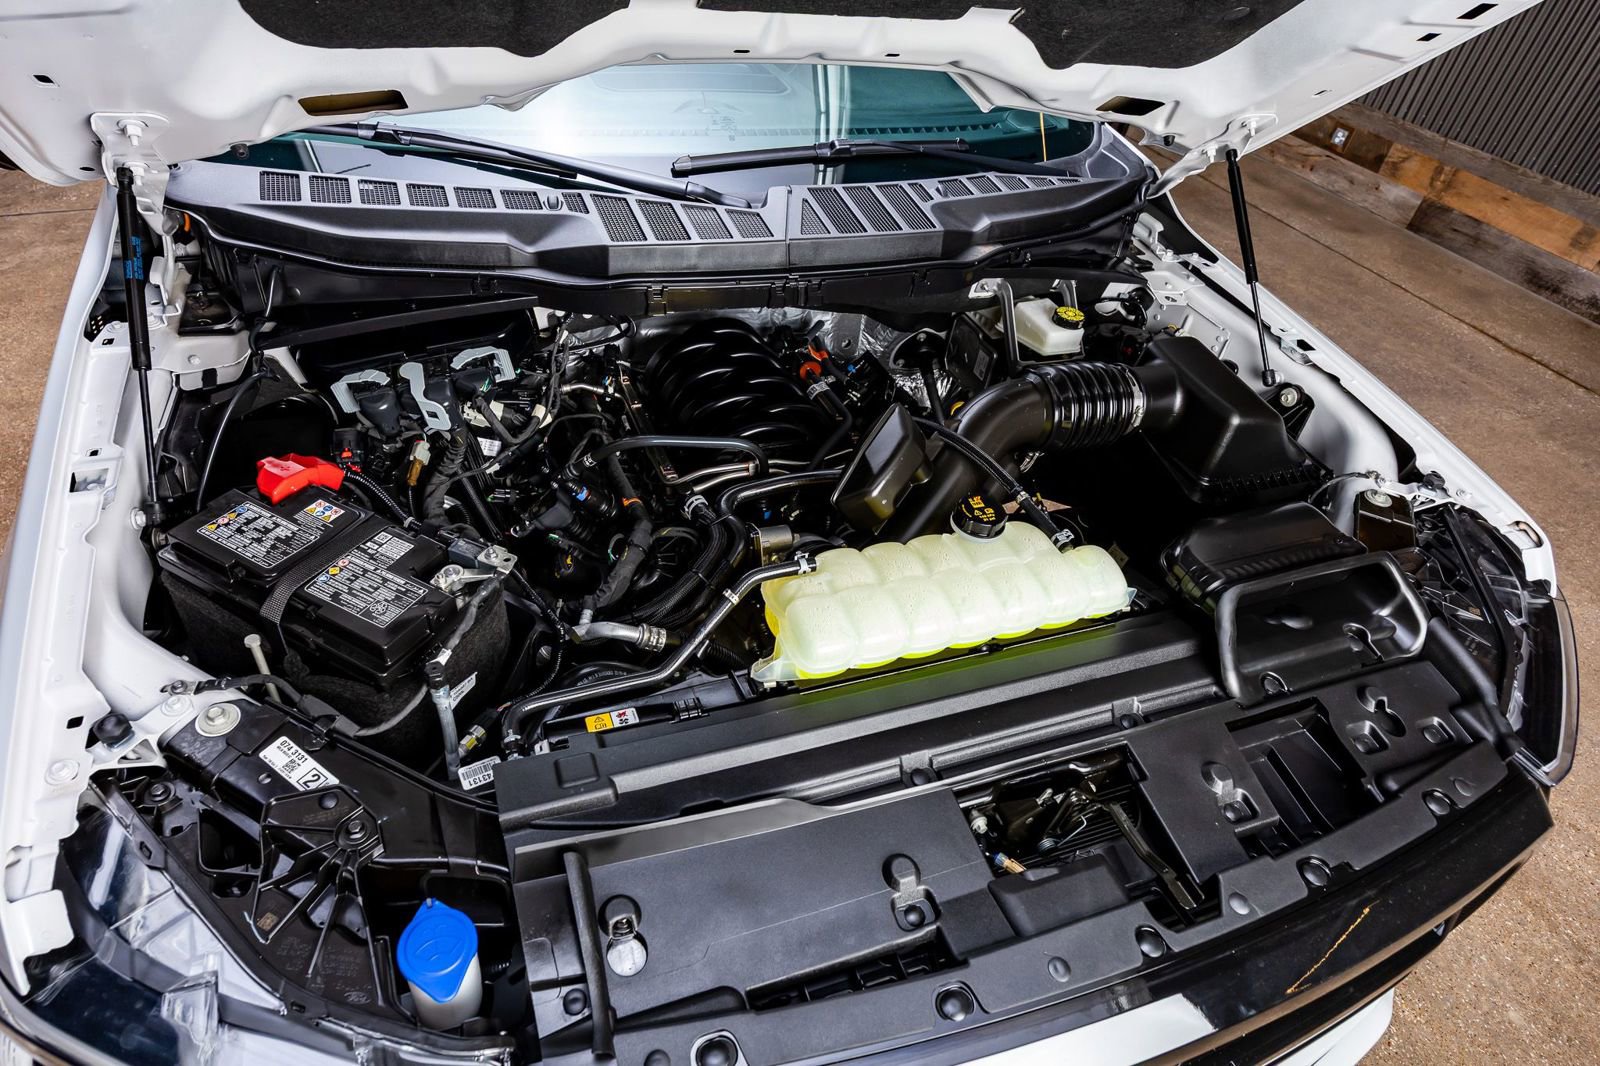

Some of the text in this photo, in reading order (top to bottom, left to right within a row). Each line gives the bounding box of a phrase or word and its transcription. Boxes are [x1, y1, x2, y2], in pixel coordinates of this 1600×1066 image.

[280, 740, 293, 751] 074
[291, 749, 308, 763] 3131
[302, 773, 321, 788] 2
